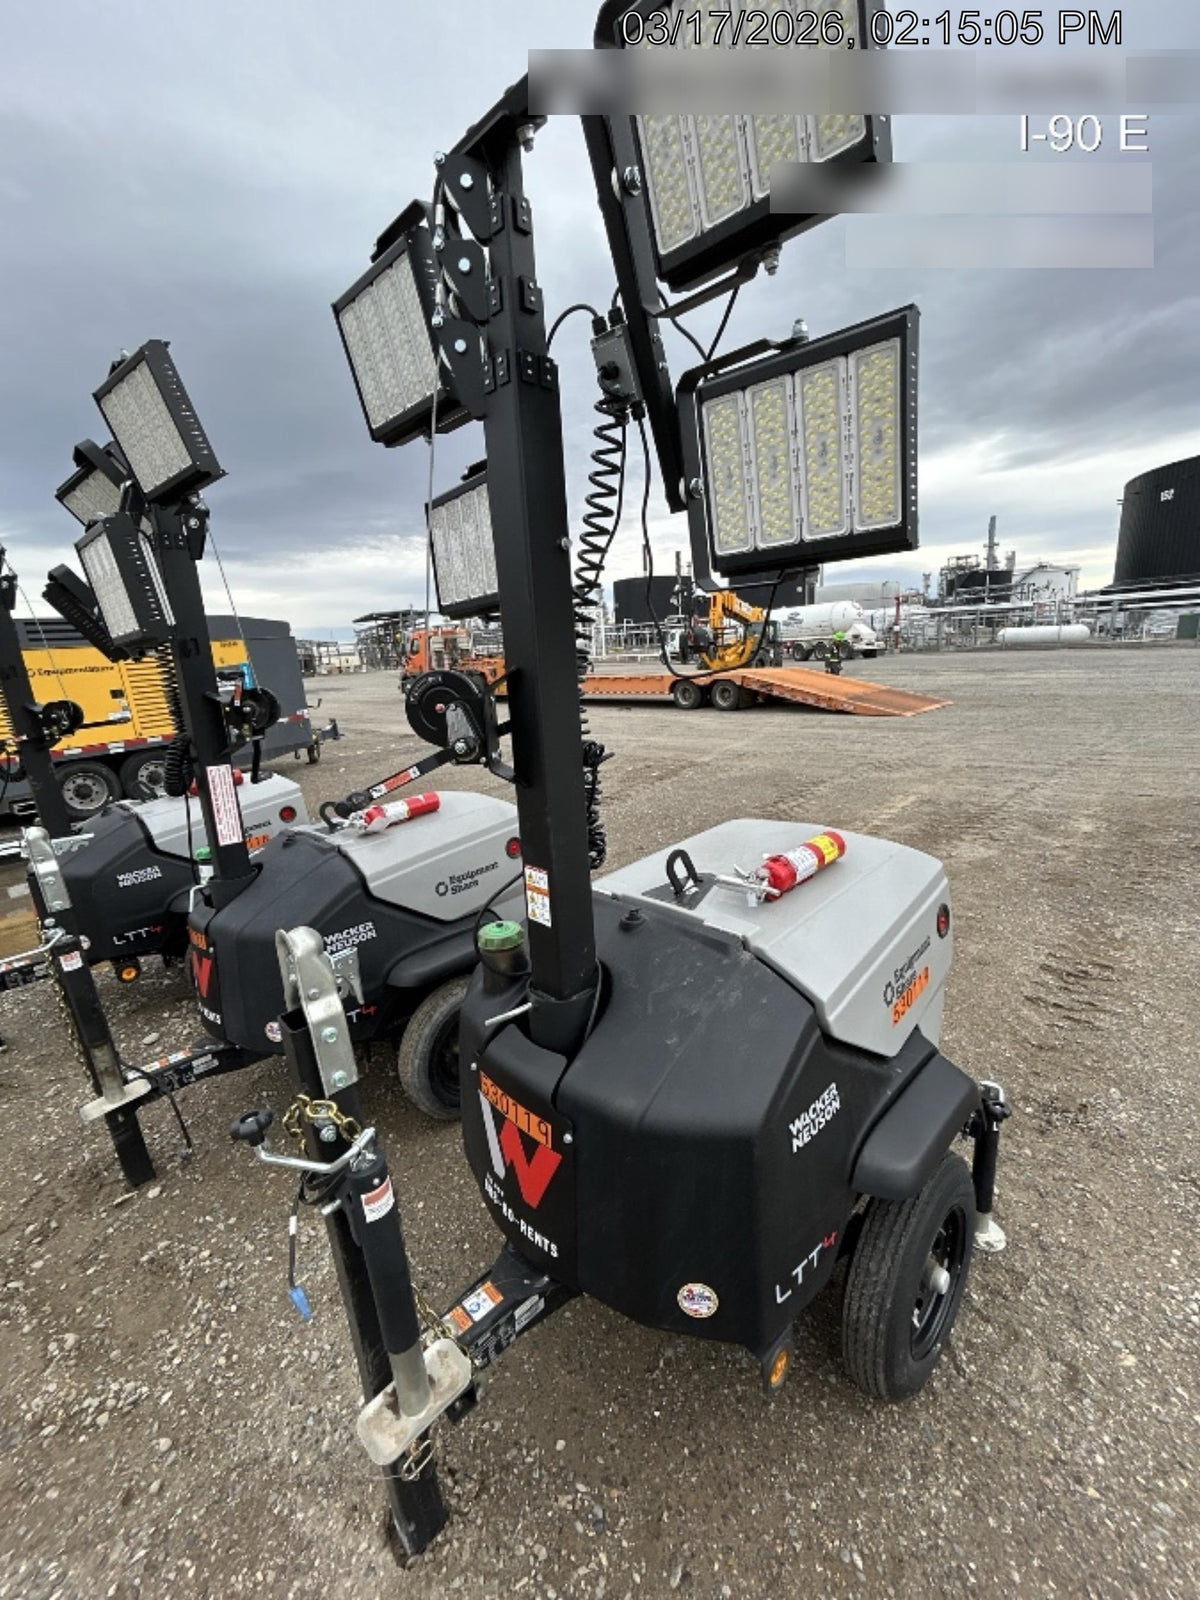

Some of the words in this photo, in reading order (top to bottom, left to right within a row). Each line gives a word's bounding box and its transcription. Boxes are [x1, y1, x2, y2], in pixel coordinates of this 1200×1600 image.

[323, 921, 375, 945] WACKER
[327, 930, 377, 953] NEUSON
[480, 1073, 551, 1146] 530119
[788, 1082, 838, 1136] WACKER
[791, 1095, 841, 1153] NEUSON
